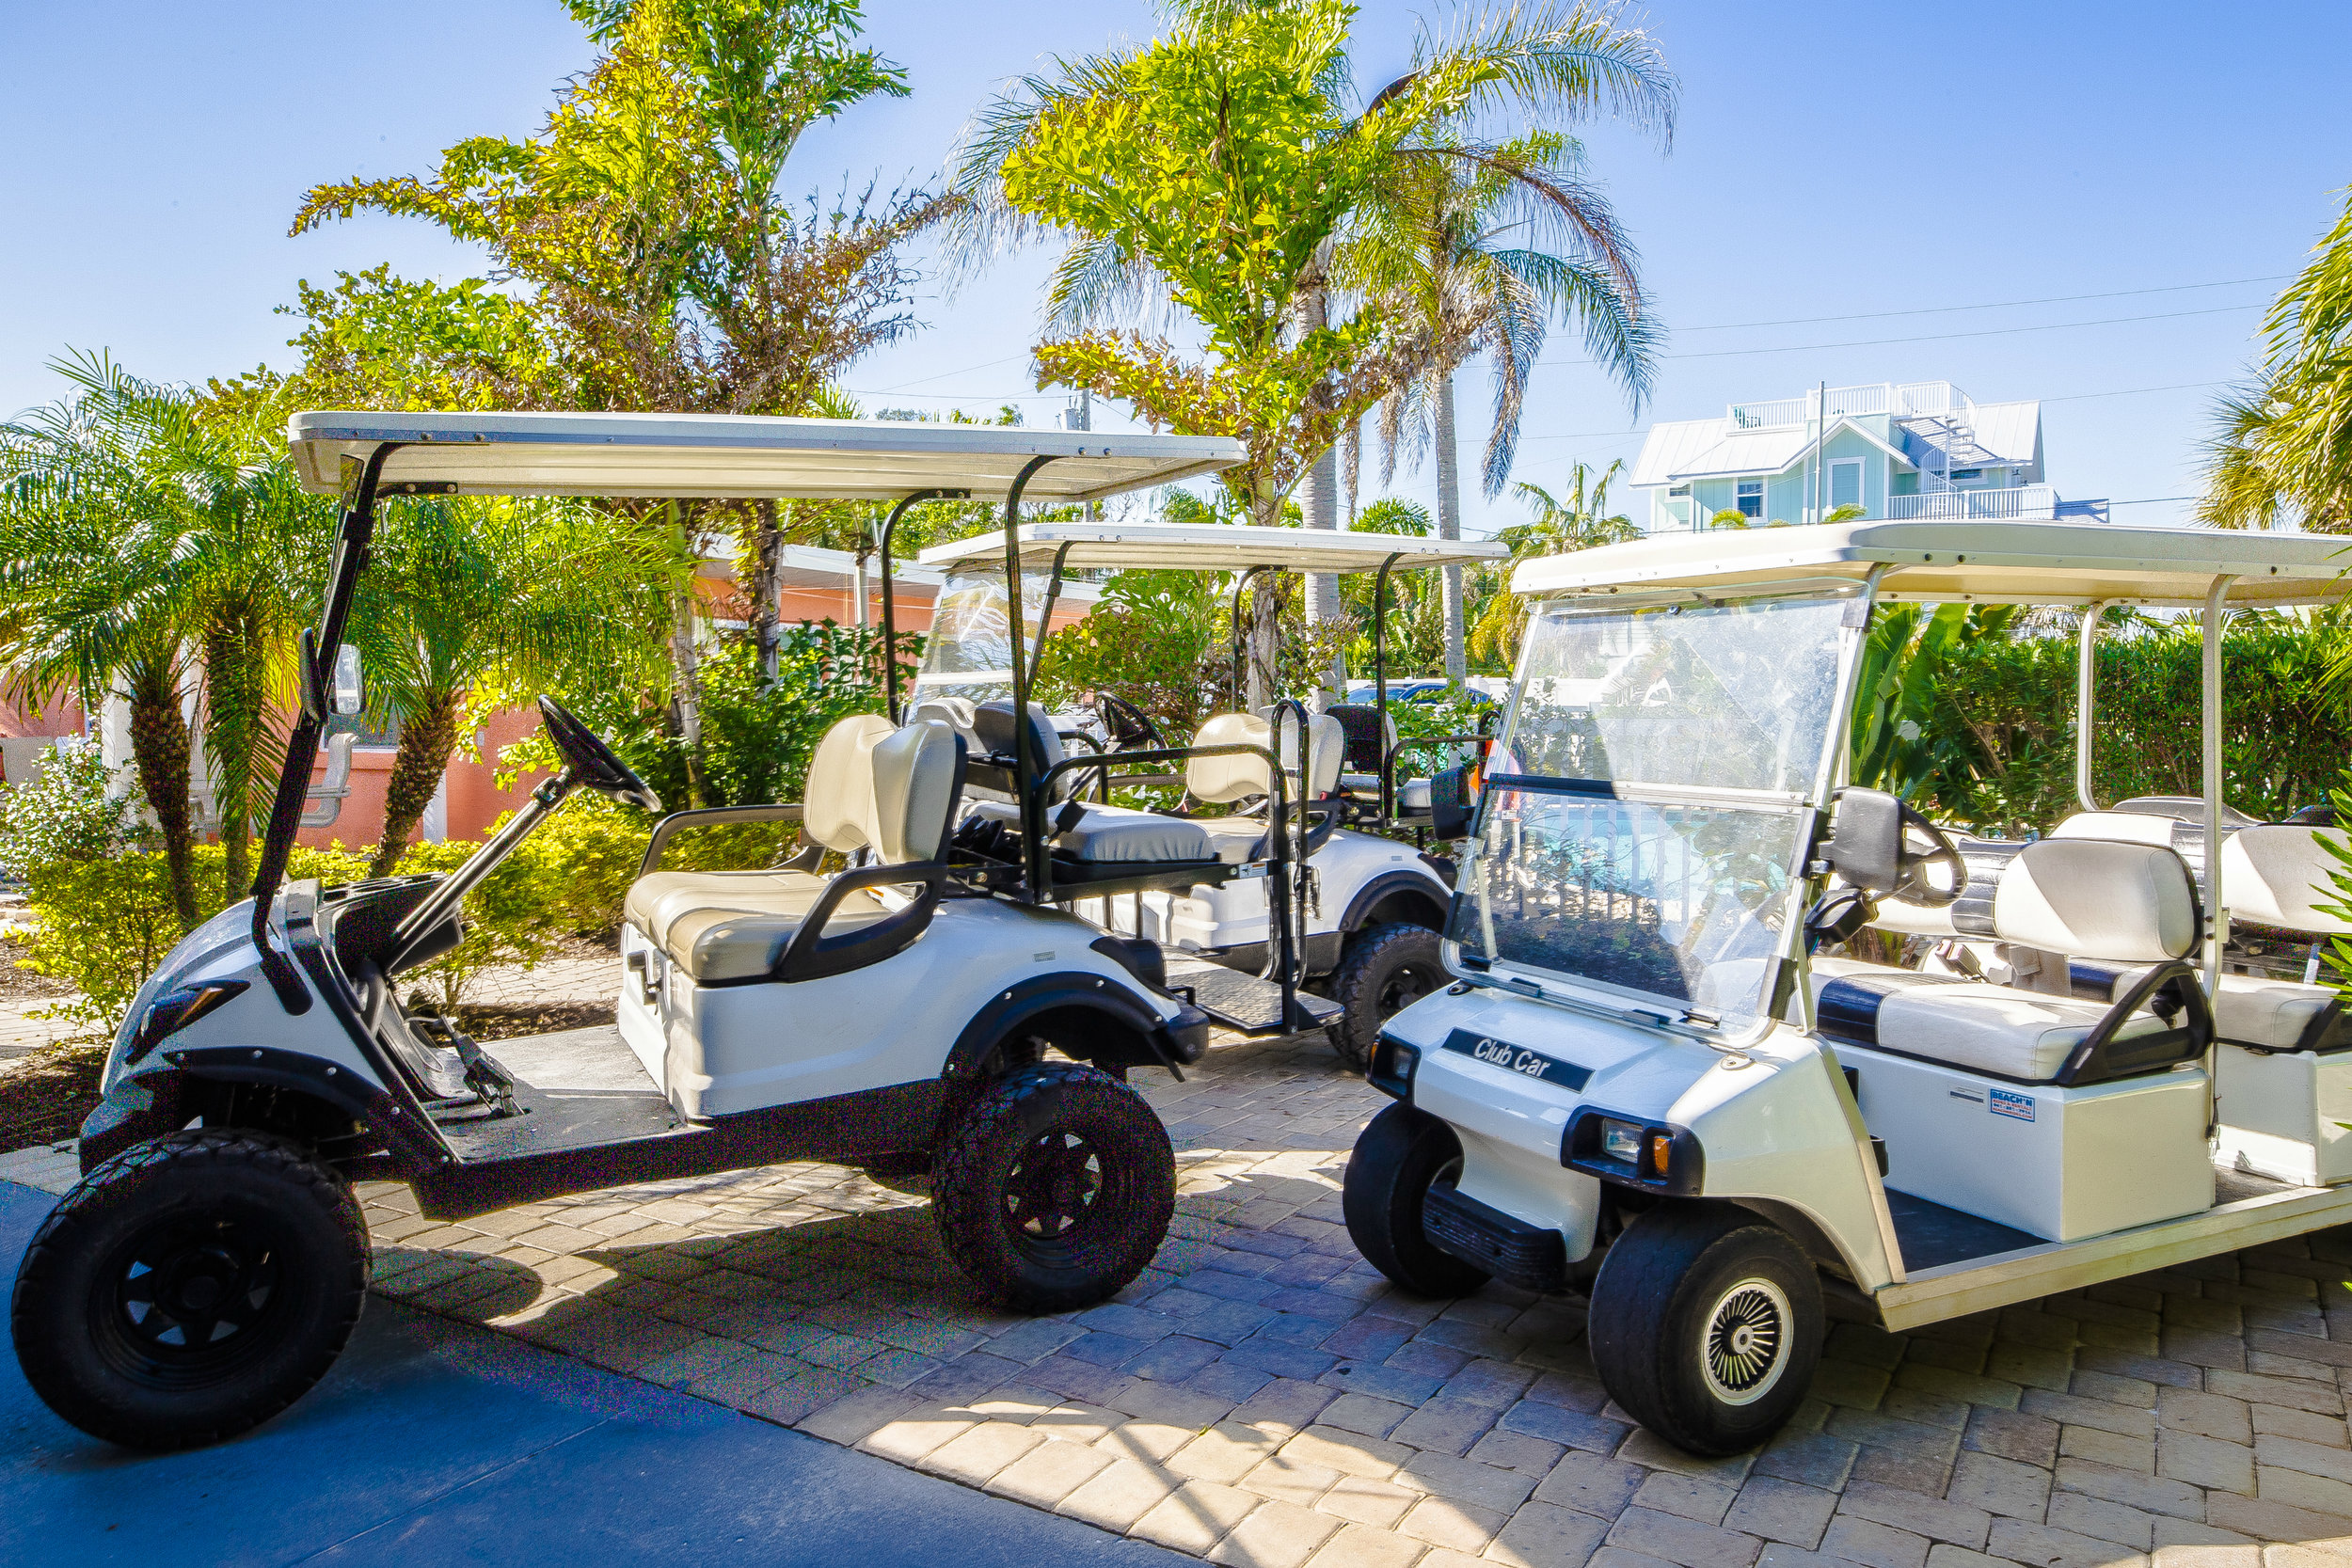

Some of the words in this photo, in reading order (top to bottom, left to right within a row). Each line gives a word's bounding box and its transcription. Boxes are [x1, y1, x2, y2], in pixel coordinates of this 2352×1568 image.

[1474, 1038, 1513, 1066] Club
[1514, 1051, 1551, 1077] Car
[1993, 1092, 2033, 1107] BEACH'N
